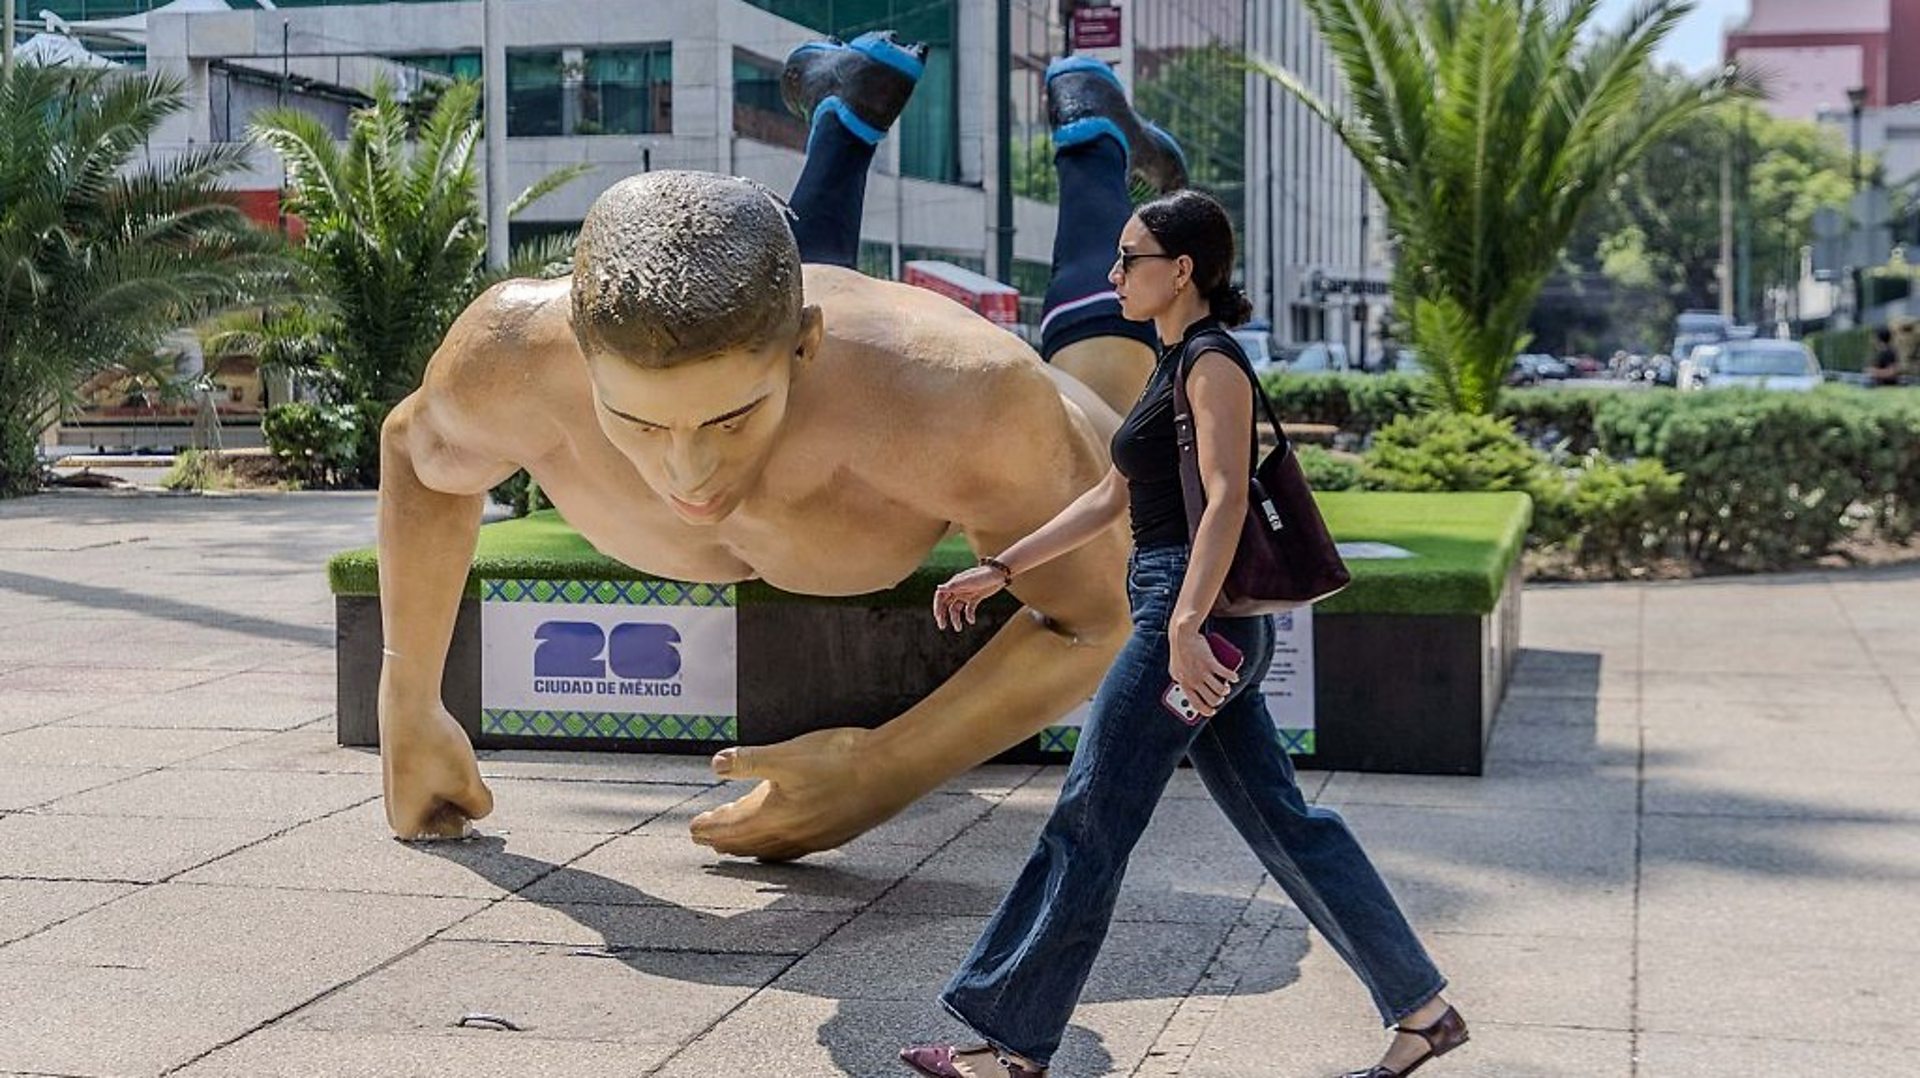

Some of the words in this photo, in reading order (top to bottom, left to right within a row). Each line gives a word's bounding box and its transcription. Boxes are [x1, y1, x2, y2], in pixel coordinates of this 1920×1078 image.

[534, 621, 681, 679] 26
[534, 680, 593, 694] CIUDAD
[596, 681, 616, 695] DE
[620, 679, 682, 696] MÉXICO
